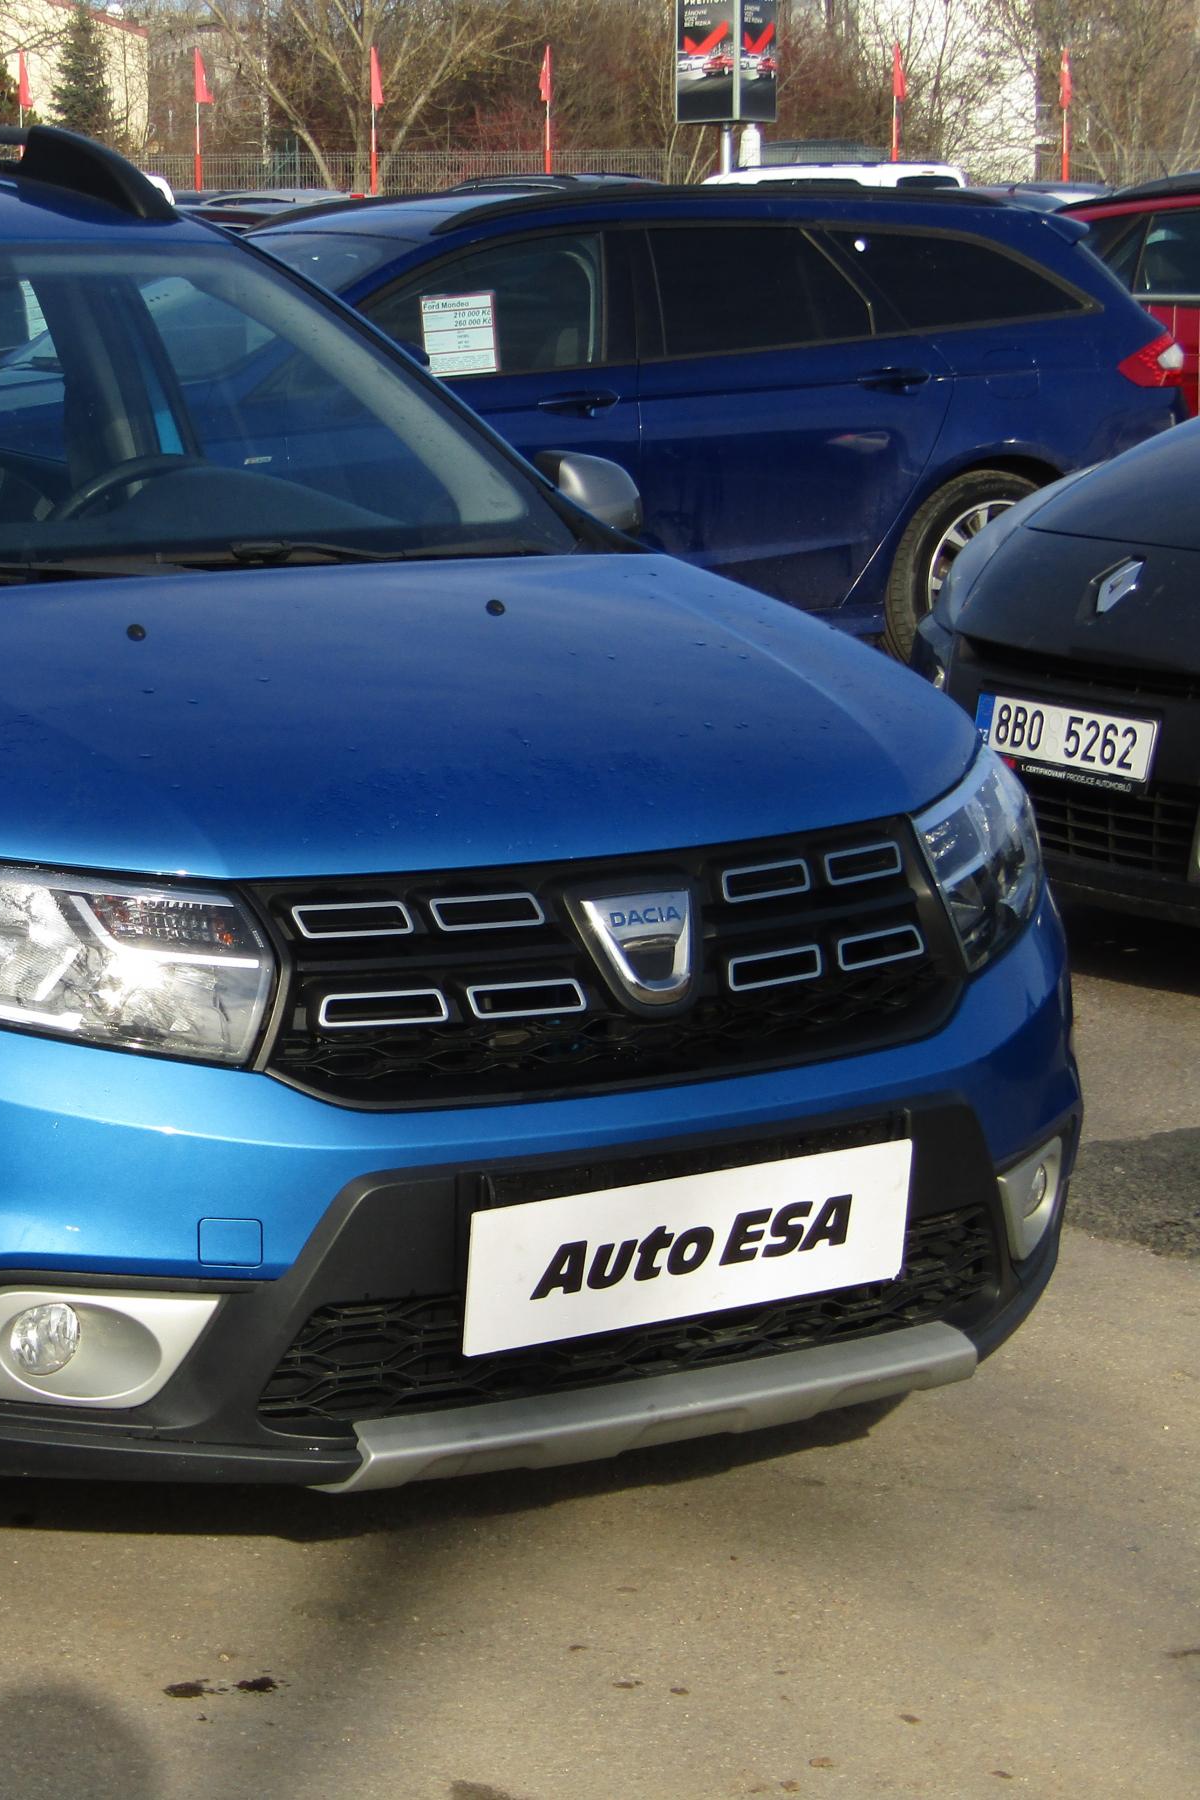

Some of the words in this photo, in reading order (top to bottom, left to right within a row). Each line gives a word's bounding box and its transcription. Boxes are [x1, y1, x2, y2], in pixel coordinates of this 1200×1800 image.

[423, 303, 440, 311] Ford
[441, 301, 470, 309] Mondeo
[453, 311, 466, 319] 210
[1063, 715, 1138, 771] 5262
[609, 906, 681, 928] DACIA
[529, 1225, 714, 1301] Auto
[718, 1193, 853, 1266] ESA
